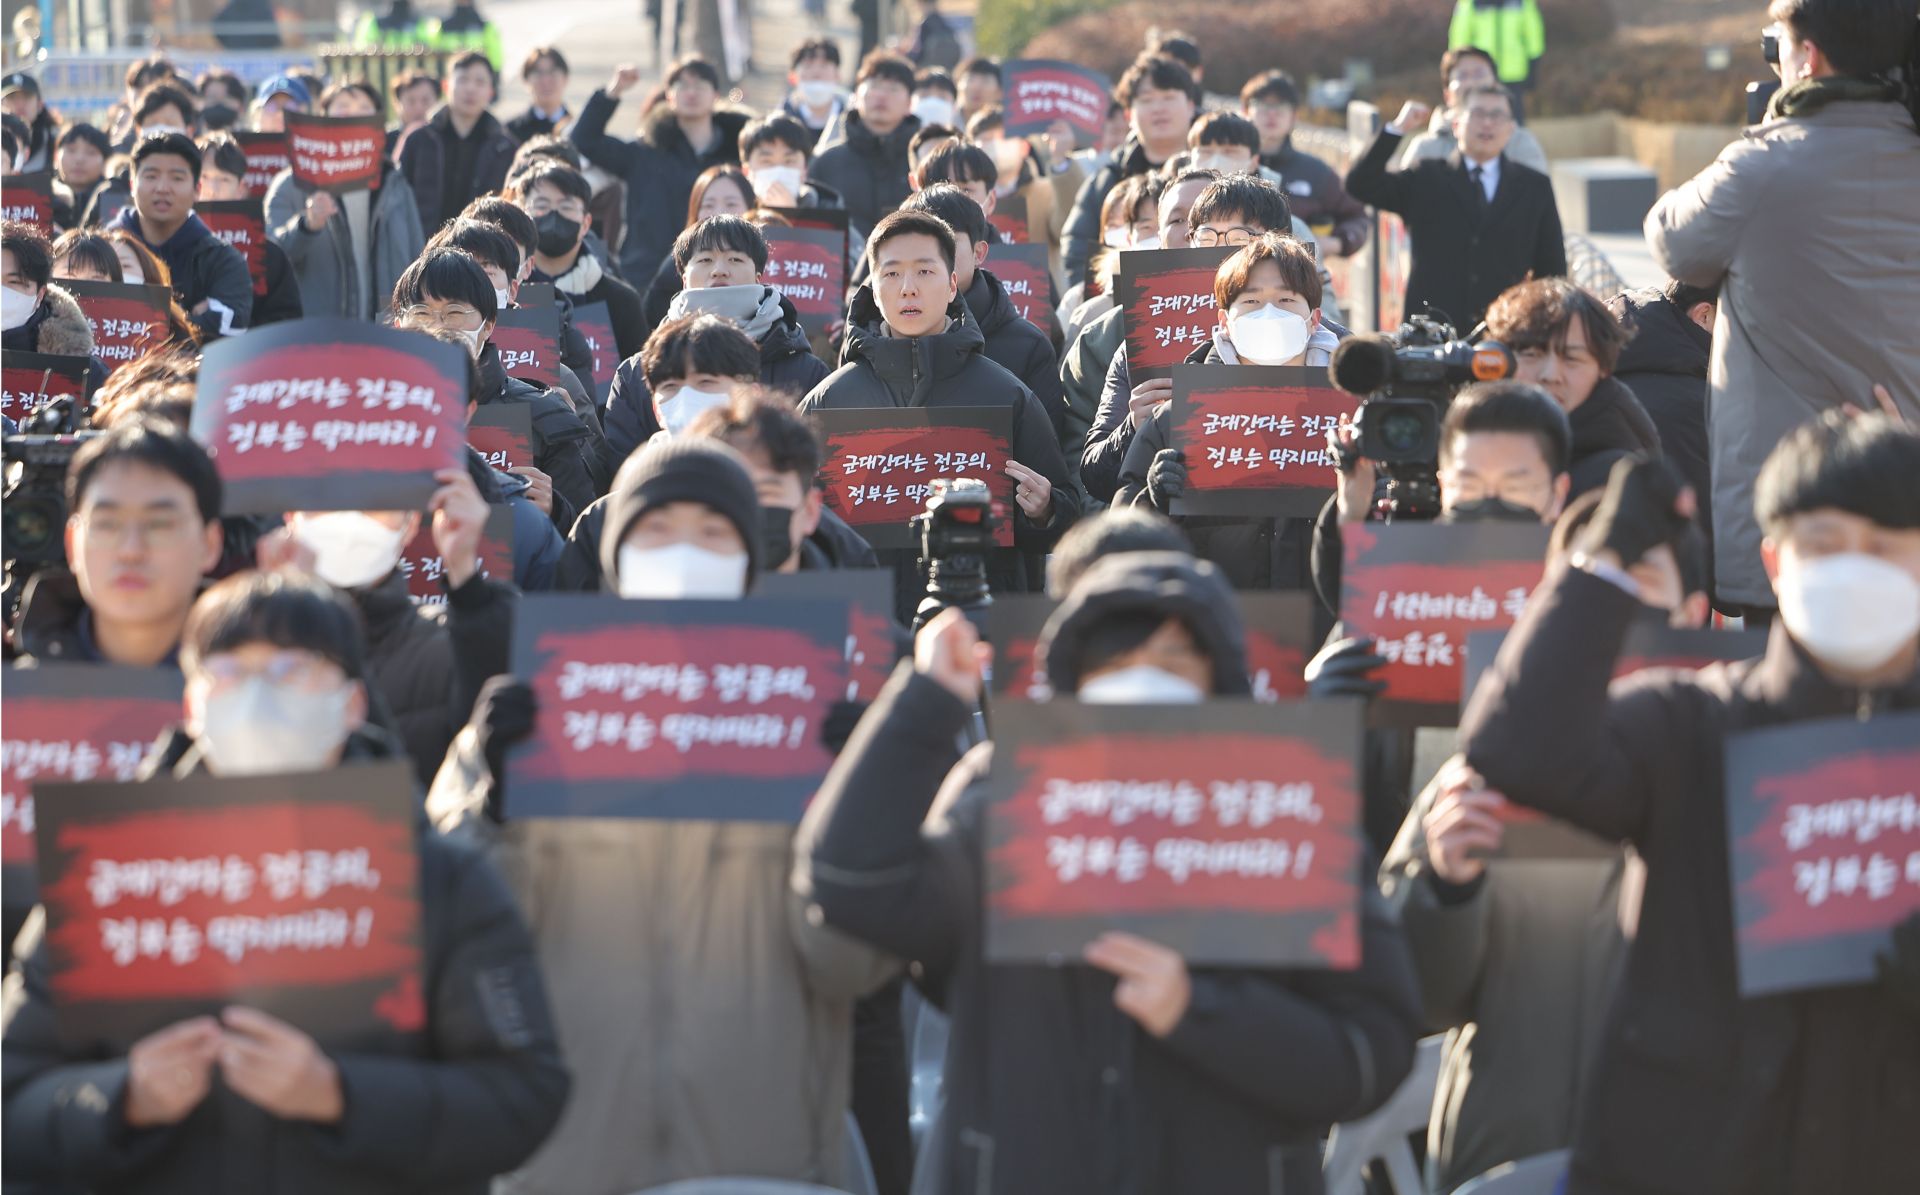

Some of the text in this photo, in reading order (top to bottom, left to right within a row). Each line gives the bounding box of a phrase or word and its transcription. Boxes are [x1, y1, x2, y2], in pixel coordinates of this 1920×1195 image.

[1149, 293, 1219, 316] 군대간다
[1154, 325, 1206, 347] 정부는
[1202, 413, 1296, 436] 군대간다는
[842, 451, 992, 475] 군대간다는 전공의,
[1206, 446, 1263, 470] 정부는
[848, 484, 900, 506] 정부는
